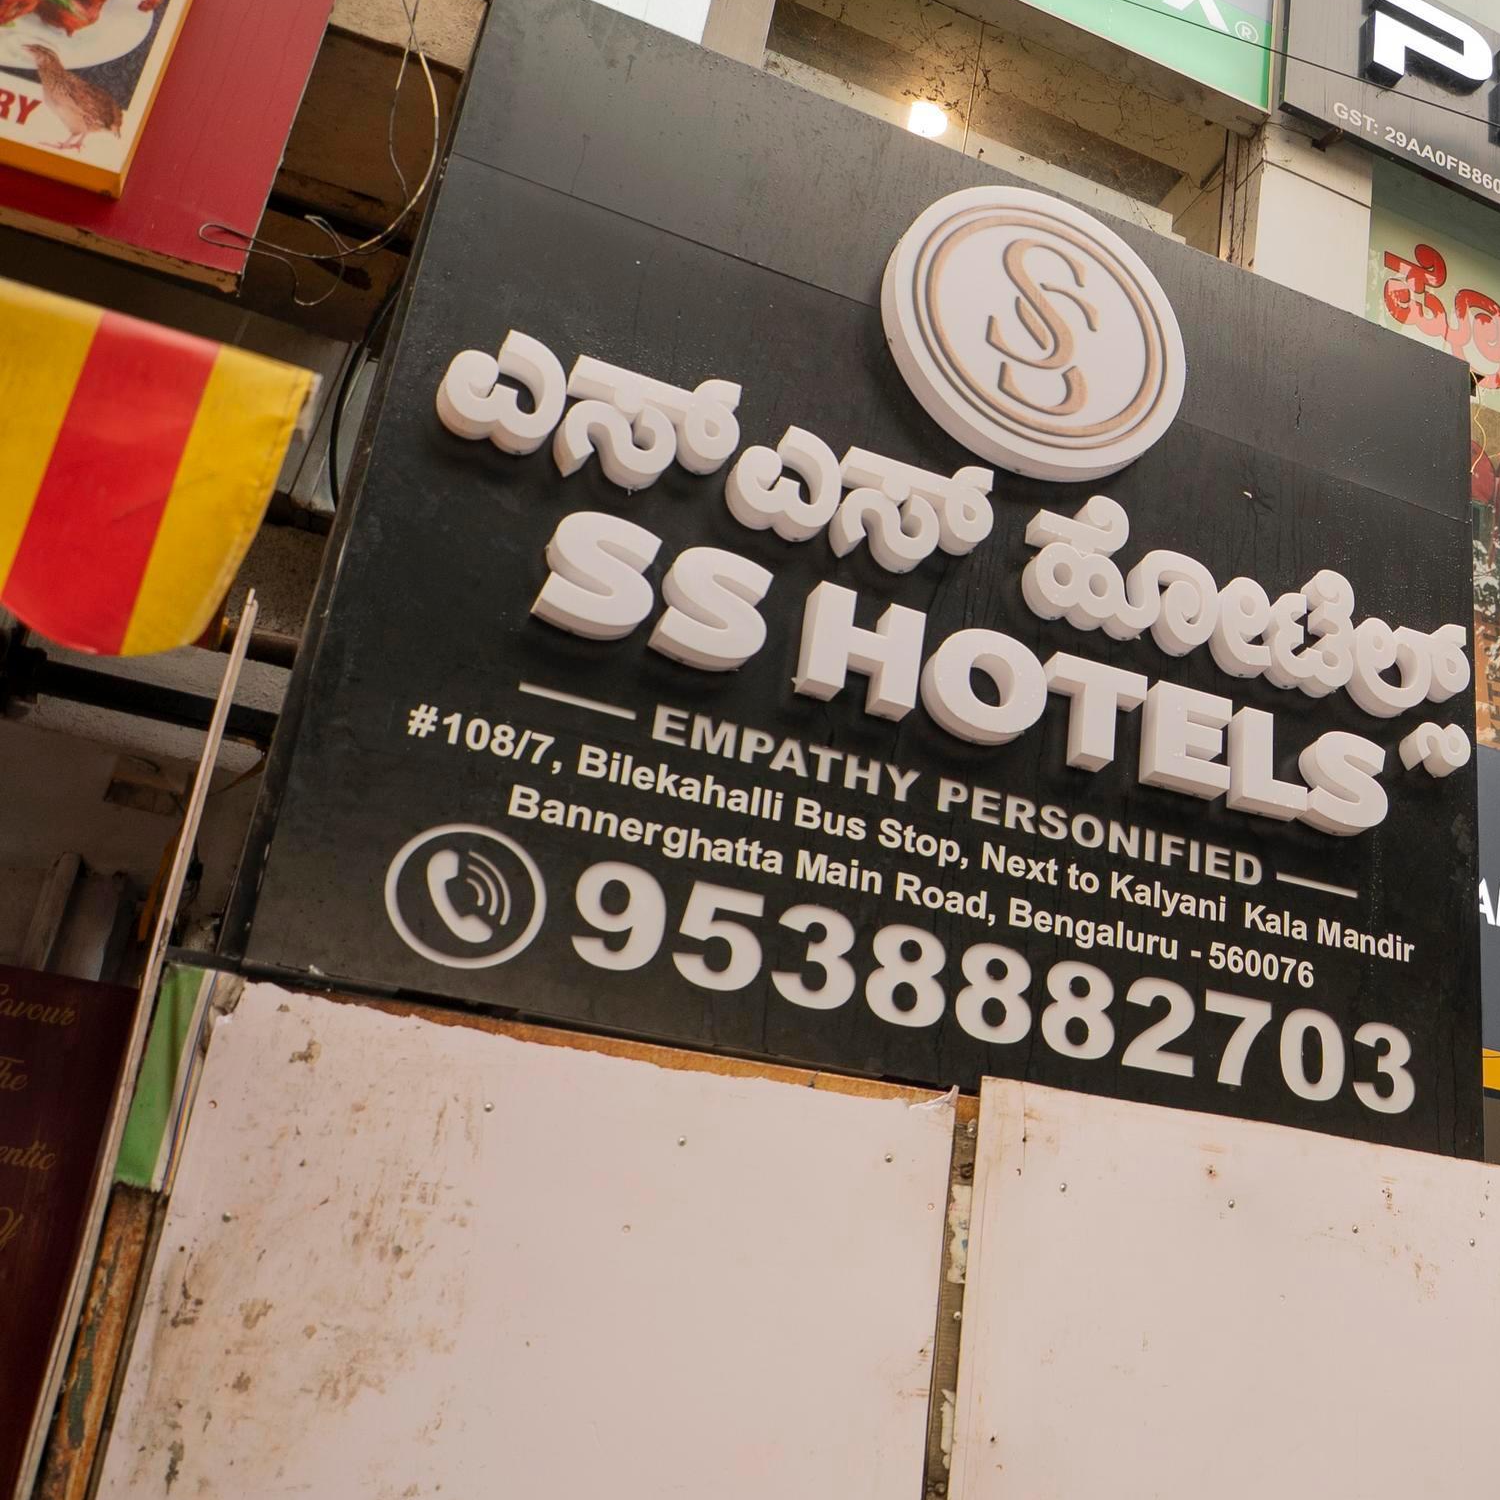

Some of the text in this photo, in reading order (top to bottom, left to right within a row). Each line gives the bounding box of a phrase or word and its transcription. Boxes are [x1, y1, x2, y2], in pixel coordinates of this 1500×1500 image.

[1333, 102, 1379, 136] GST:
[530, 511, 775, 672] SS
[794, 580, 1389, 836] HOTELS
[407, 703, 1416, 964] #108/7, Bilekahalli Bus Stop, Next to Kalyani Kala Mandir
[507, 784, 784, 874] Bannerghatta
[795, 849, 884, 894] Main
[895, 872, 997, 927] Road,
[1008, 899, 1179, 961] Bengaluru
[1208, 944, 1315, 989] 560076
[651, 703, 1264, 886] EMPATHY PERSONIFIED
[571, 860, 1416, 1115] 9538882703
